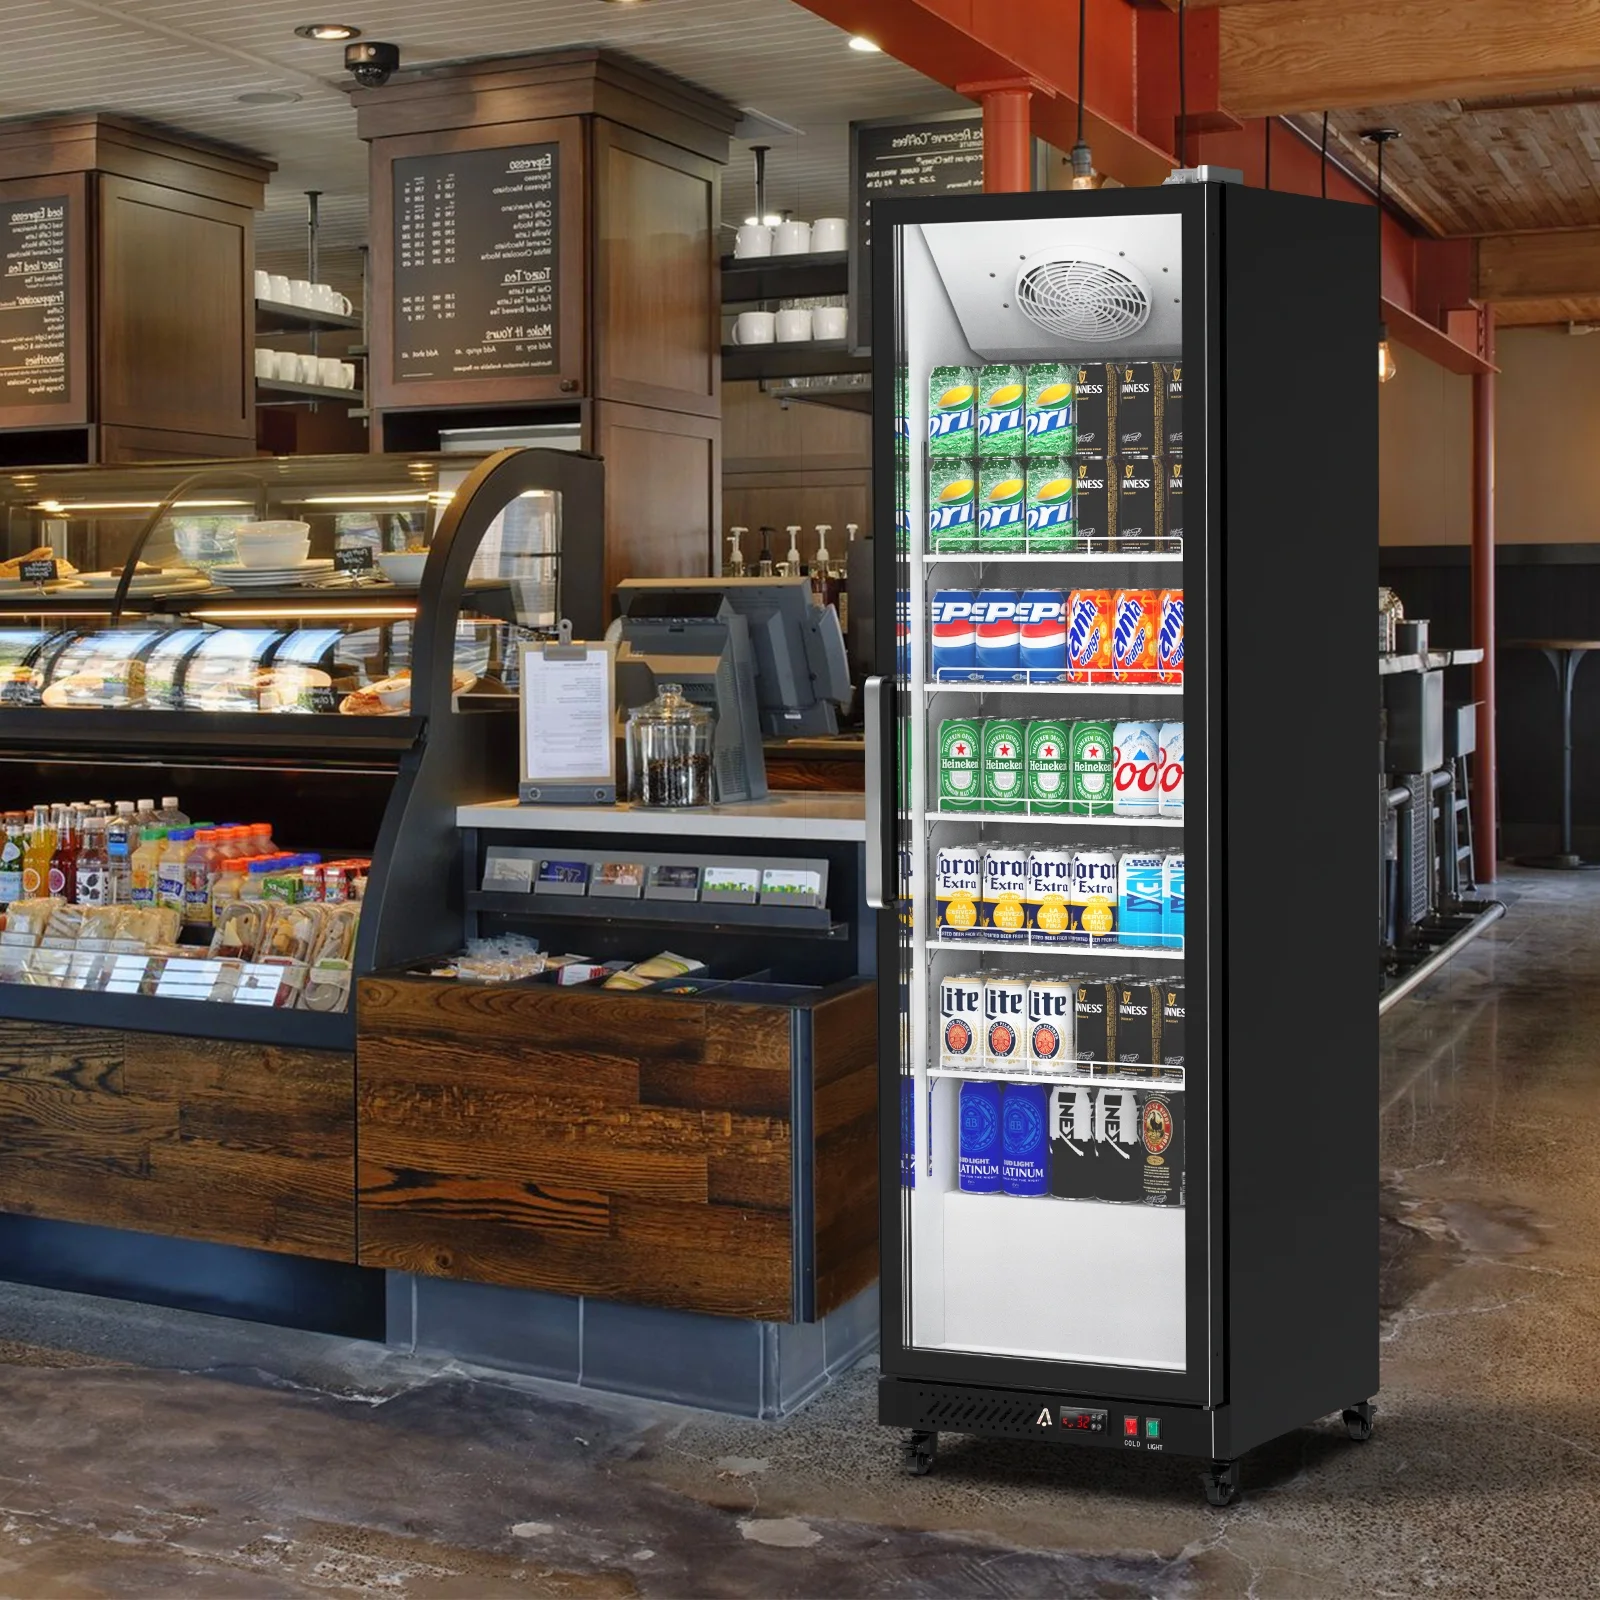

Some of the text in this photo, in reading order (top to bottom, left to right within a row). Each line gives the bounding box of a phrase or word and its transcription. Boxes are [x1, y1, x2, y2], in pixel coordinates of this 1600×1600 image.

[1080, 627, 1100, 667] orange
[1125, 627, 1146, 667] orange
[942, 759, 979, 769] Heineken
[986, 760, 1023, 770] Heineken
[1030, 761, 1067, 771] Heineken
[1074, 762, 1112, 772] Heineken
[943, 876, 977, 888] Extra
[990, 878, 1024, 890] Extra
[1035, 879, 1069, 891] Extra
[1079, 881, 1113, 893] Extra
[941, 986, 978, 1017] Lite
[985, 988, 1022, 1020] Lite
[1029, 989, 1067, 1022] Lite
[1147, 1443, 1163, 1451] LIGHT
